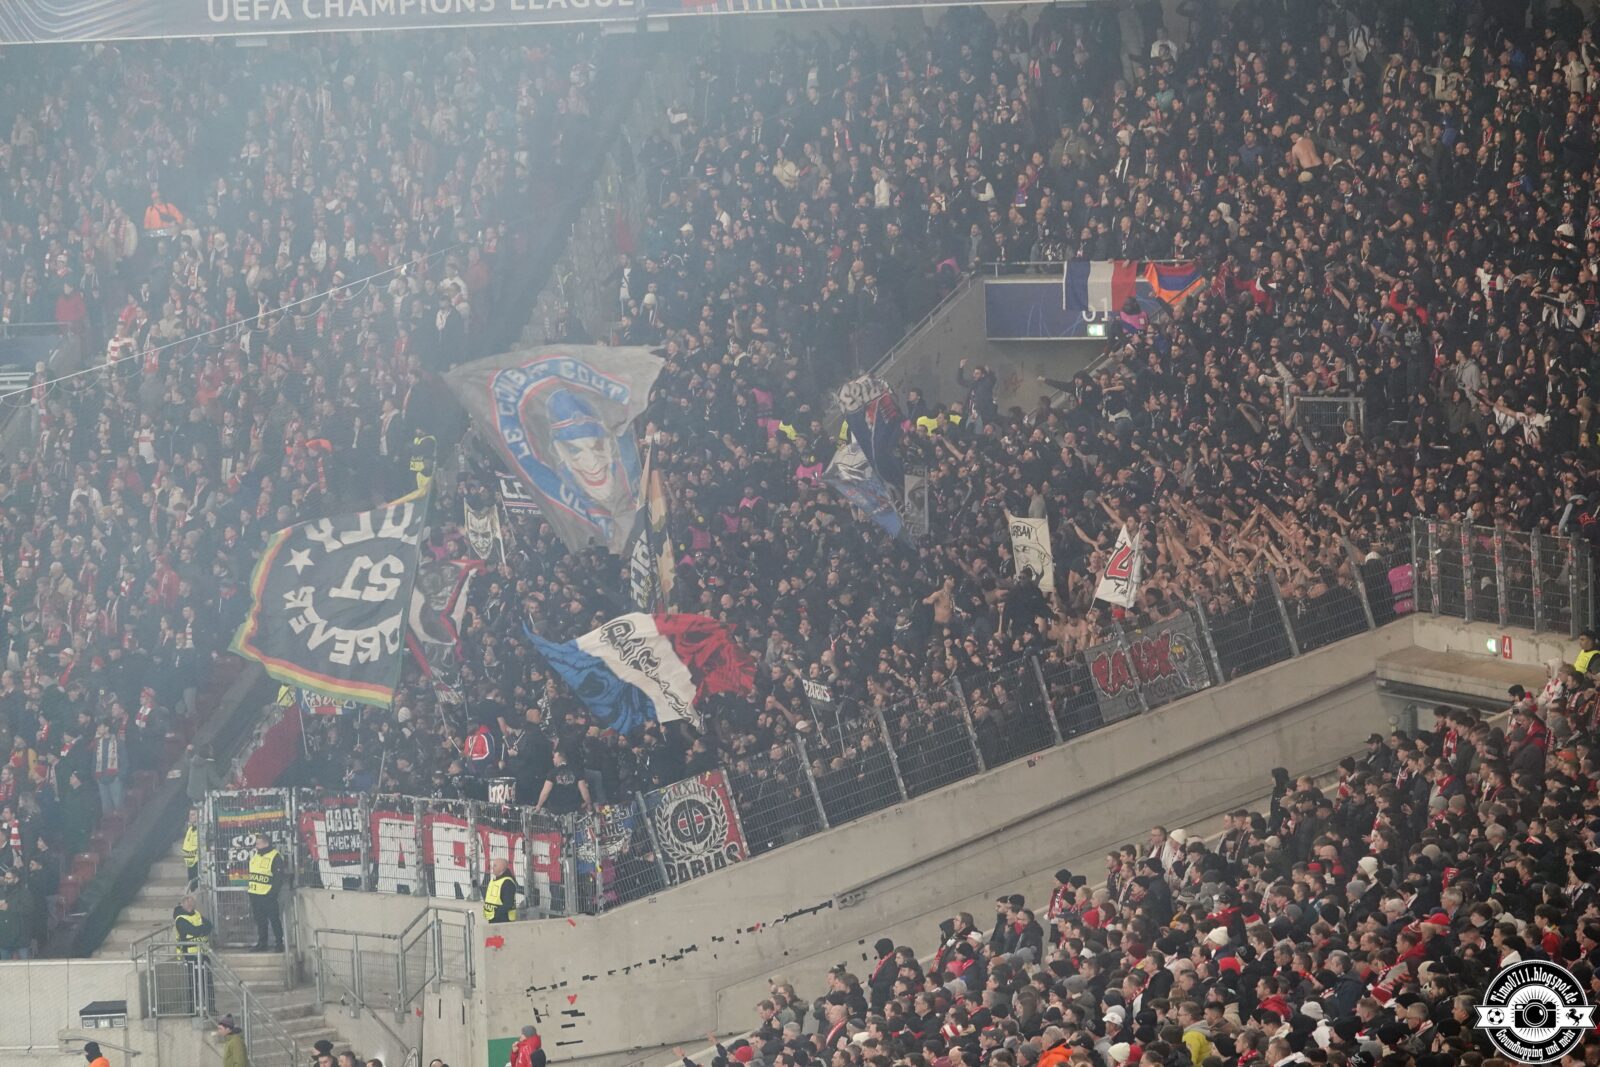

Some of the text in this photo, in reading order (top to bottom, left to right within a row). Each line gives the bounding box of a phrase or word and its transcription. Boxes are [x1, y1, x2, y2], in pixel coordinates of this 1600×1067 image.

[207, 0, 292, 22] UEFA
[1503, 637, 1511, 657] 4
[665, 843, 743, 887] PARIAS
